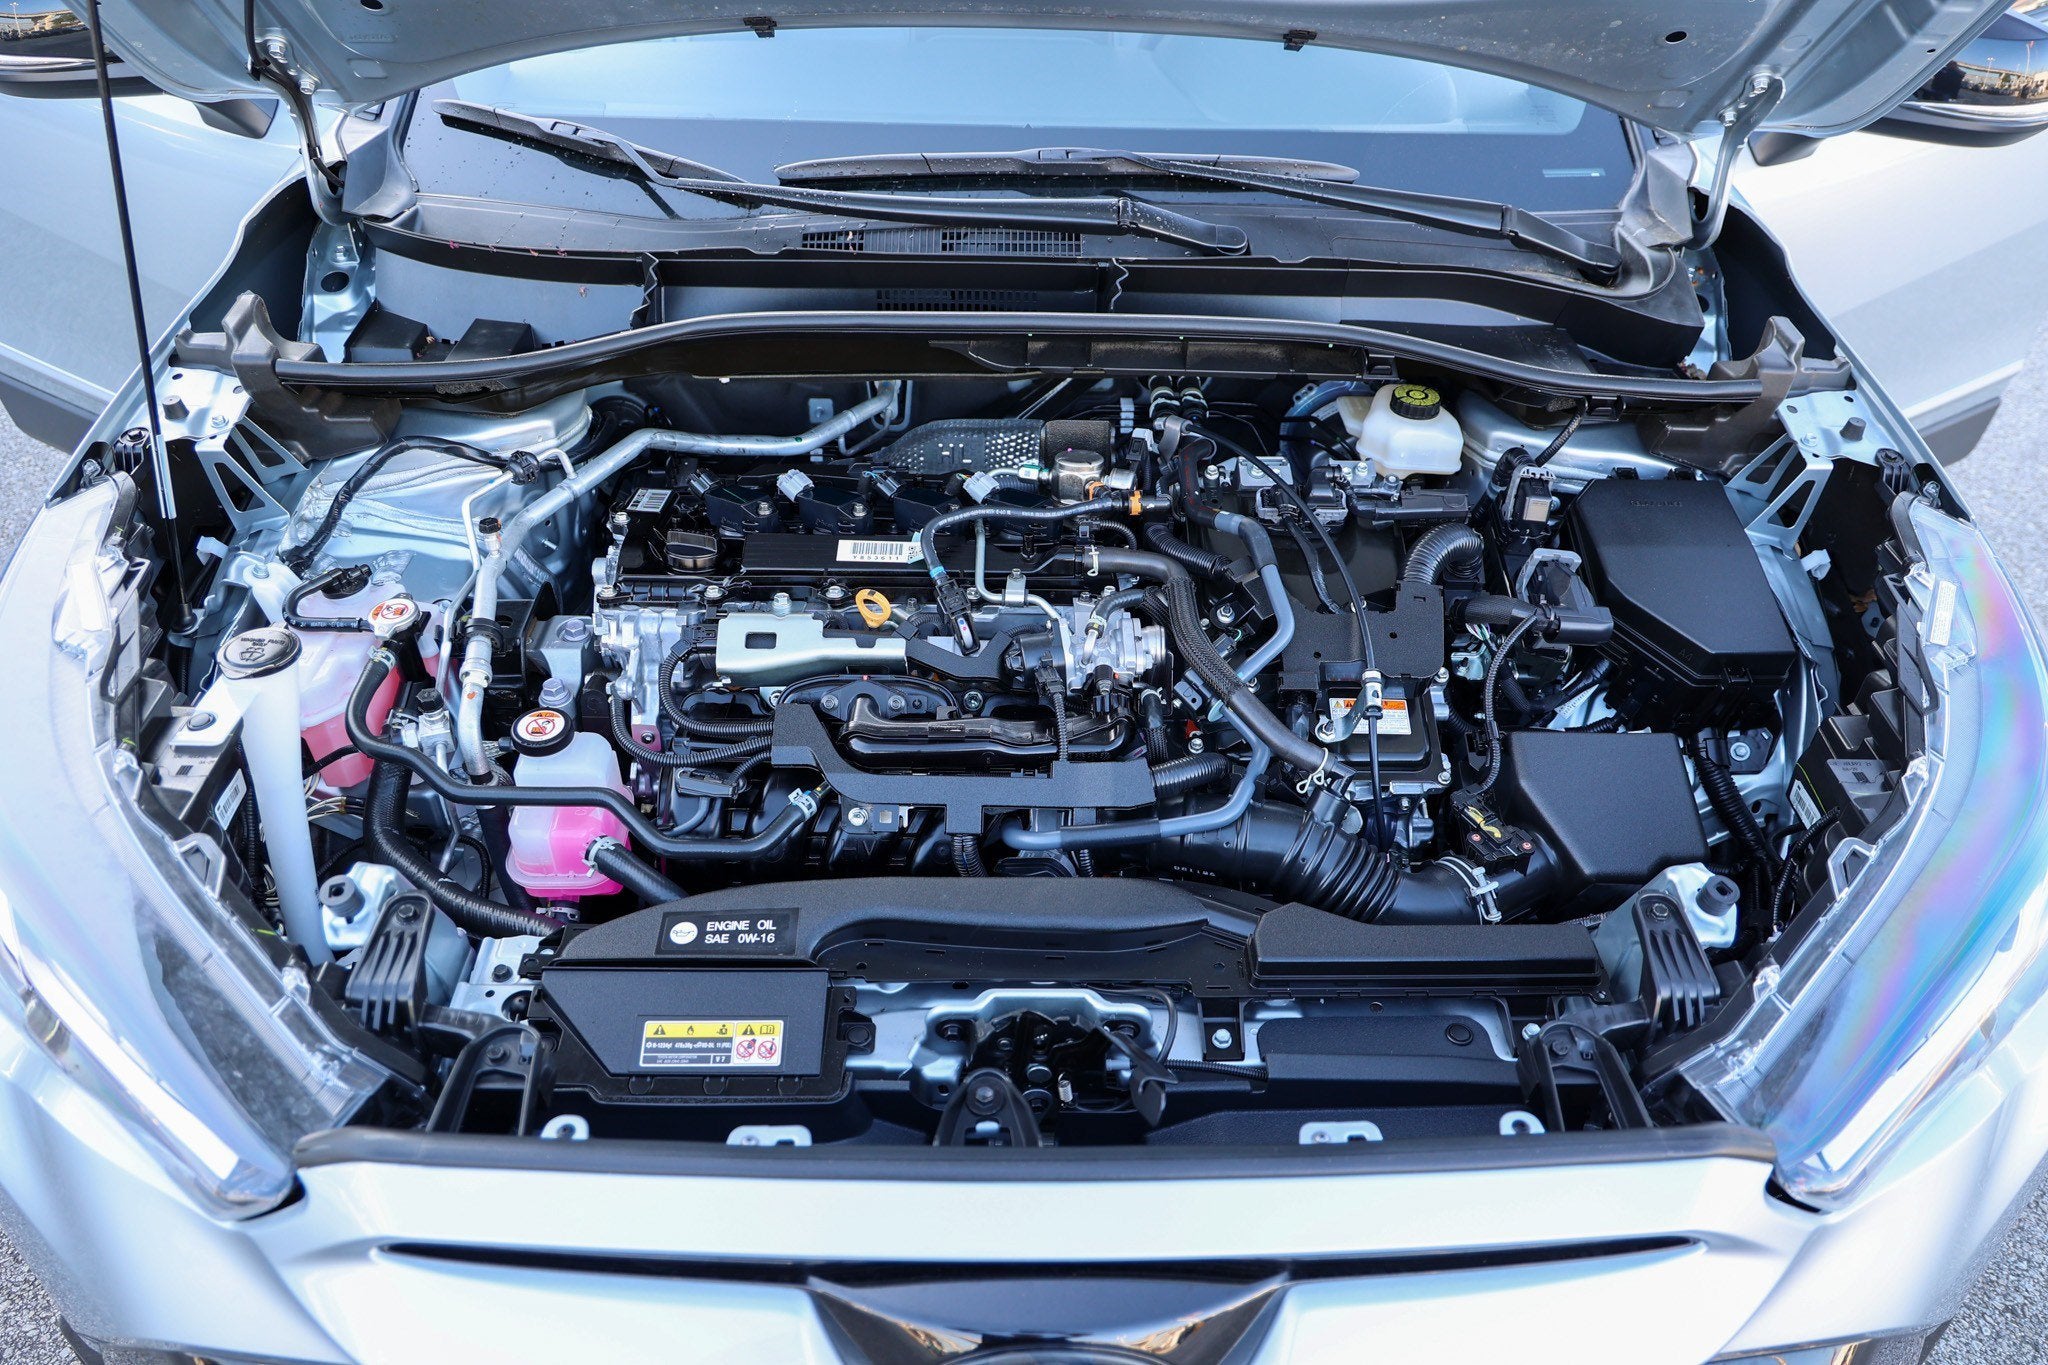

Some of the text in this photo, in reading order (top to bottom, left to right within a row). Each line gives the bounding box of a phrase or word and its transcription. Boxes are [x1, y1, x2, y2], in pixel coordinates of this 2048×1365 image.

[706, 919, 777, 932] ENGINE OIL
[704, 933, 776, 944] SAE 0W-16
